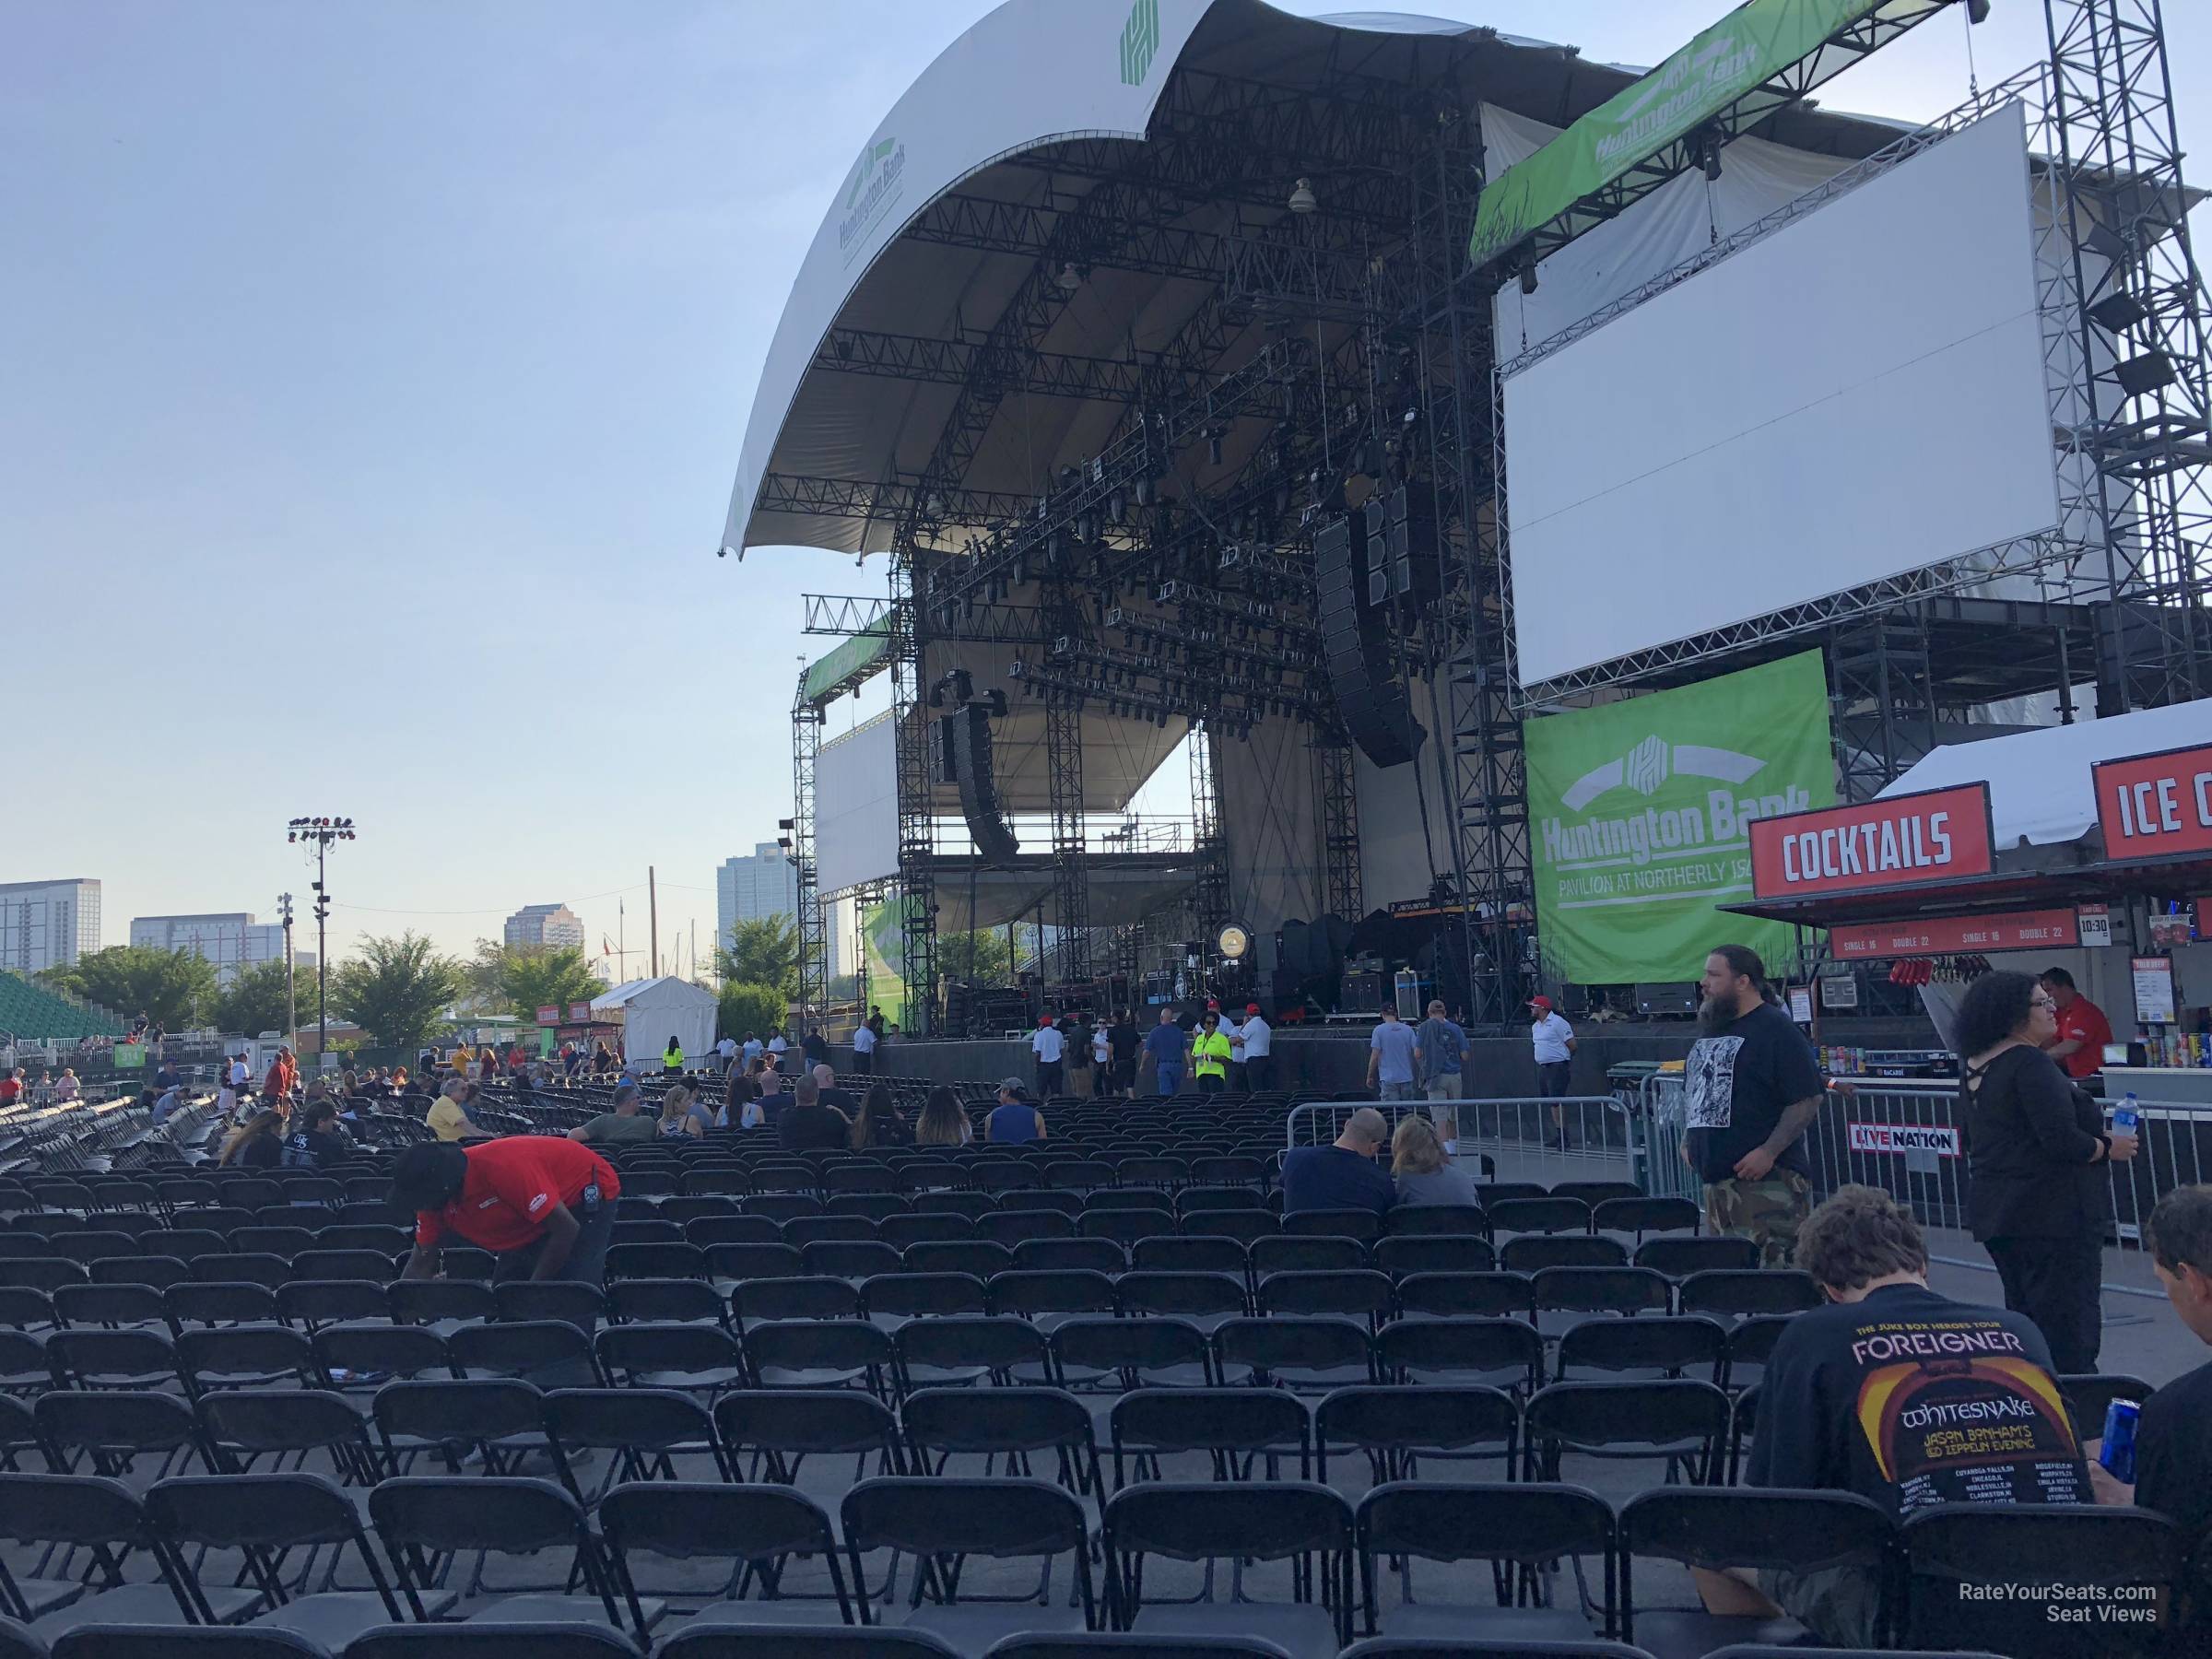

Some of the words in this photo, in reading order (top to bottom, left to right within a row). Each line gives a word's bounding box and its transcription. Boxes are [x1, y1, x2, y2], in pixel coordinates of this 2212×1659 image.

[839, 175, 884, 250] Huntington
[882, 144, 906, 186] Bank
[2118, 777, 2182, 837] ICE
[1542, 806, 1704, 865] Huntington
[1783, 811, 1951, 882] COCKTAILS
[1559, 876, 1613, 897] PAVILION
[1617, 872, 1630, 892] AT
[1634, 861, 1725, 889] NORTHERLY
[1844, 941, 1865, 951] SINGLE
[1892, 937, 1917, 948] DOUBLE
[1921, 935, 1929, 946] 22
[1962, 933, 1987, 943] SINGLE
[2019, 928, 2048, 939] DOUBLE
[2053, 928, 2063, 937] 22
[2081, 920, 2107, 932] 10:30
[1856, 1127, 1890, 1146] LIVE
[1892, 1131, 1952, 1148] NATION
[1853, 1331, 2025, 1365] FOREIGNER
[1856, 1327, 1876, 1335] THE
[1924, 1430, 1965, 1448] JASON
[1967, 1425, 2033, 1441] BONHAM'S
